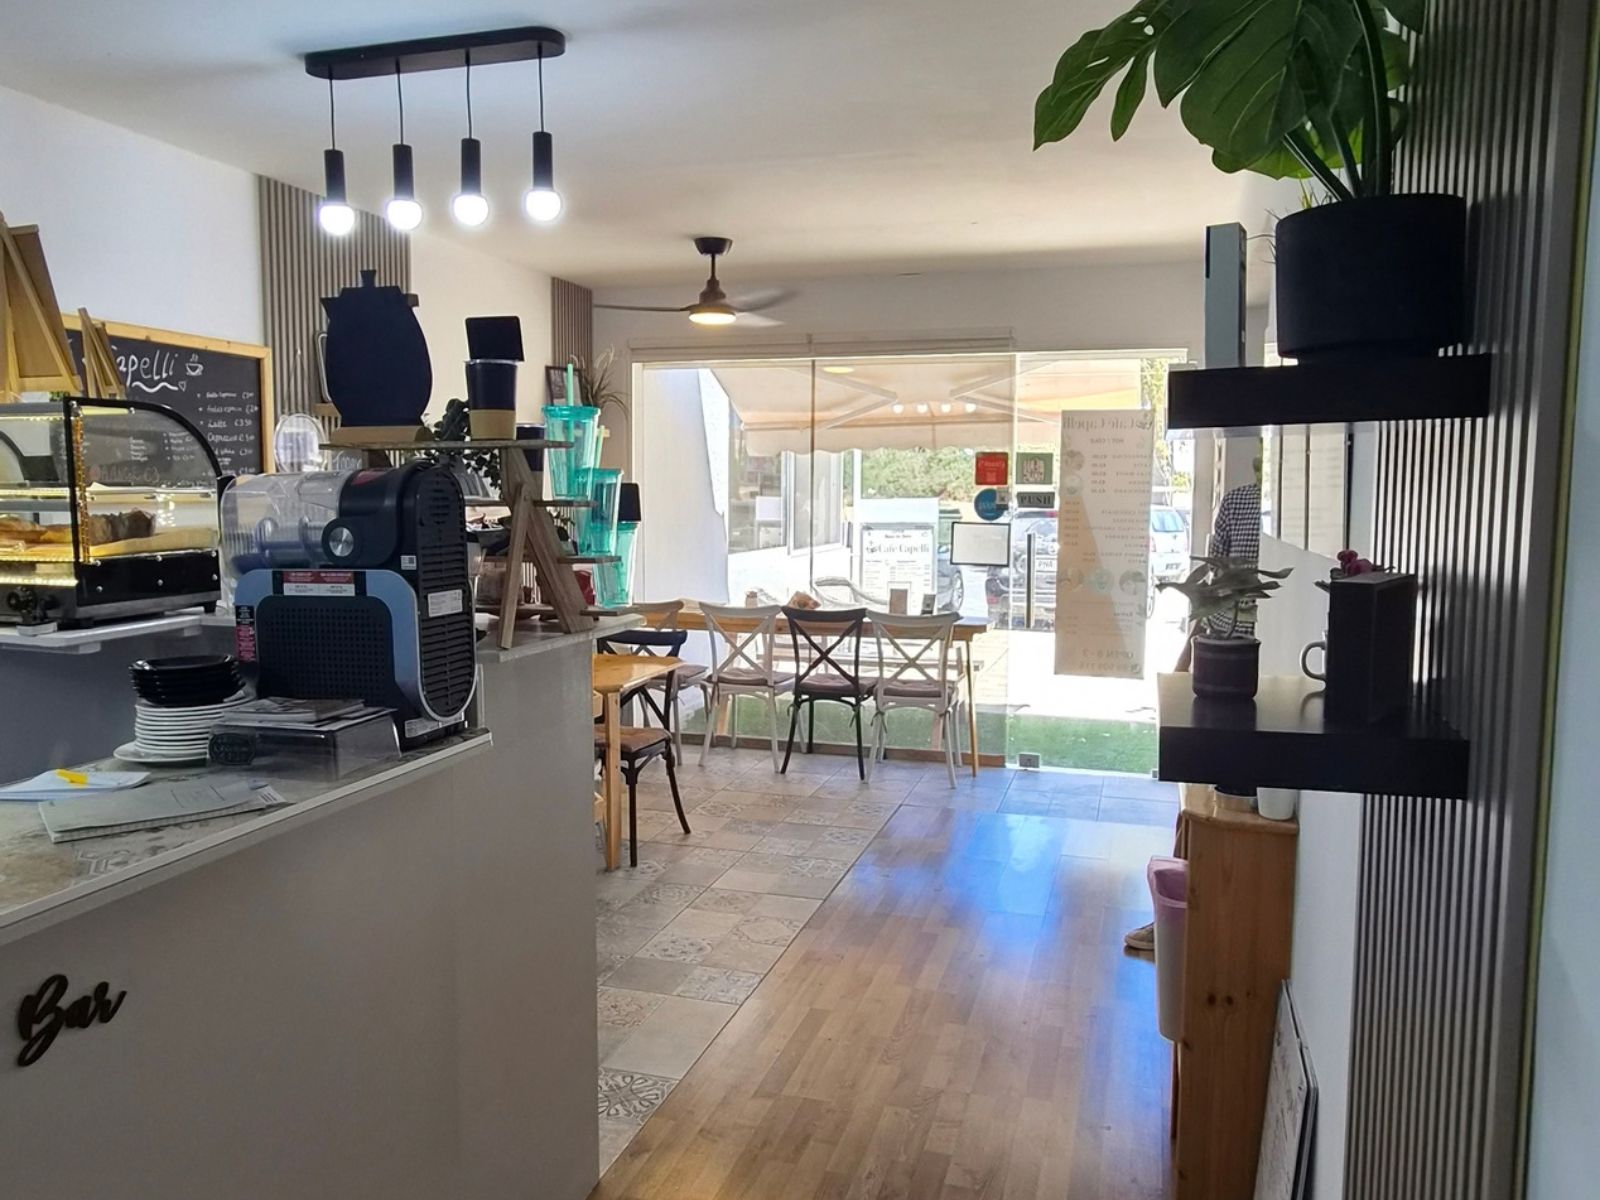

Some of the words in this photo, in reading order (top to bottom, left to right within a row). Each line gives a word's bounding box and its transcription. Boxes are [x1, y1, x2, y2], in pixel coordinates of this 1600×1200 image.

[111, 345, 179, 388] apelli
[1020, 495, 1051, 505] PUSH
[17, 974, 127, 1067] Bar
